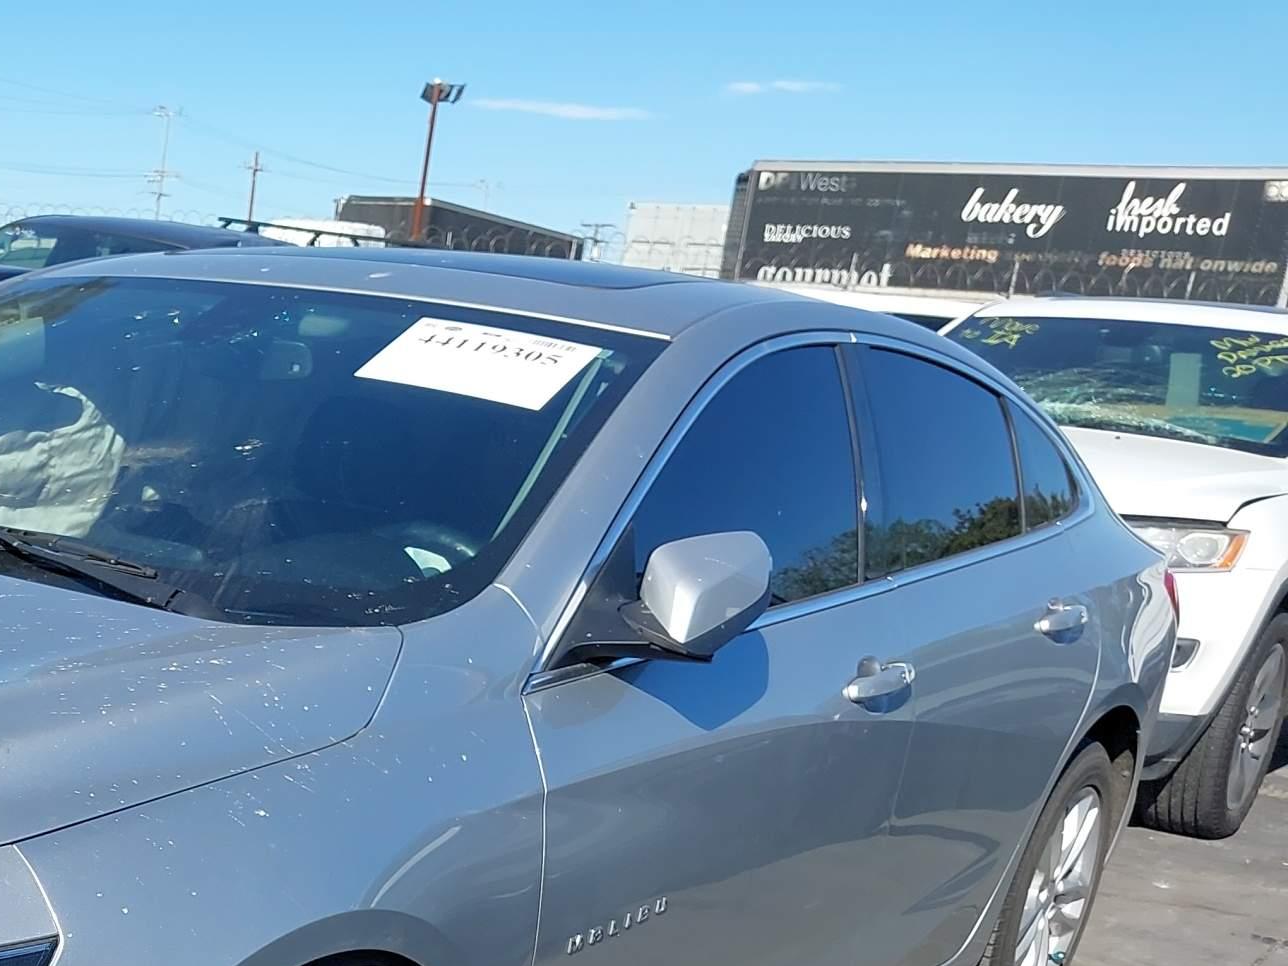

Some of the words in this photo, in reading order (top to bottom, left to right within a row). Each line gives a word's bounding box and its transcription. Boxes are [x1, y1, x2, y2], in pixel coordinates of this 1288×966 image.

[800, 171, 847, 192] West
[961, 186, 1066, 239] bakery
[1106, 208, 1232, 238] imported
[905, 243, 999, 263] Marketing
[1158, 256, 1278, 274] natonwide
[418, 334, 563, 365] 44119305
